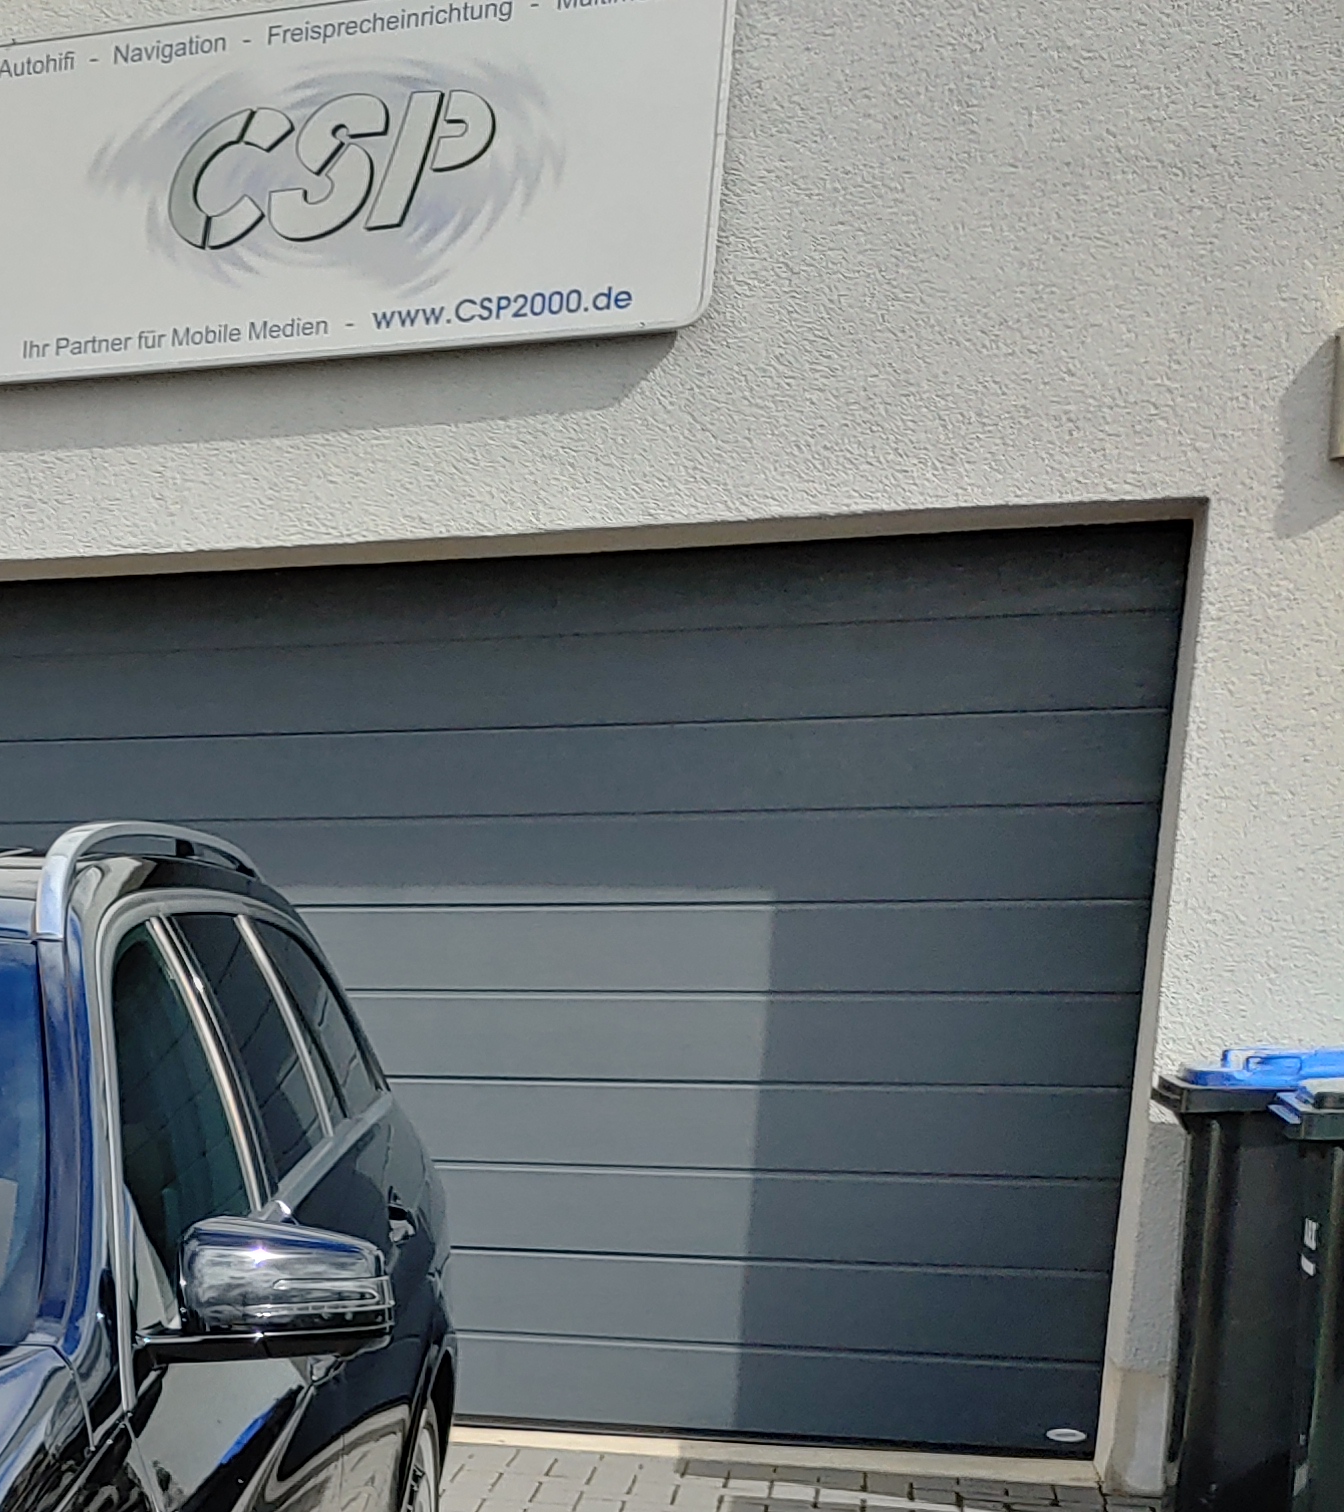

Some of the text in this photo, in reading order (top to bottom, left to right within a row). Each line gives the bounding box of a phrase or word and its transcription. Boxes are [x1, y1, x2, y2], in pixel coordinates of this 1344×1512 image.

[113, 35, 226, 65] Navigation
[267, 1, 512, 46] Freisprecheinrichtung
[168, 89, 496, 250] CSP
[22, 339, 50, 359] Ihr
[55, 336, 132, 357] Partner
[138, 329, 167, 350] für
[171, 322, 242, 347] Mobile
[248, 317, 329, 341] Medien
[371, 286, 633, 330] www.CSP2000.de
